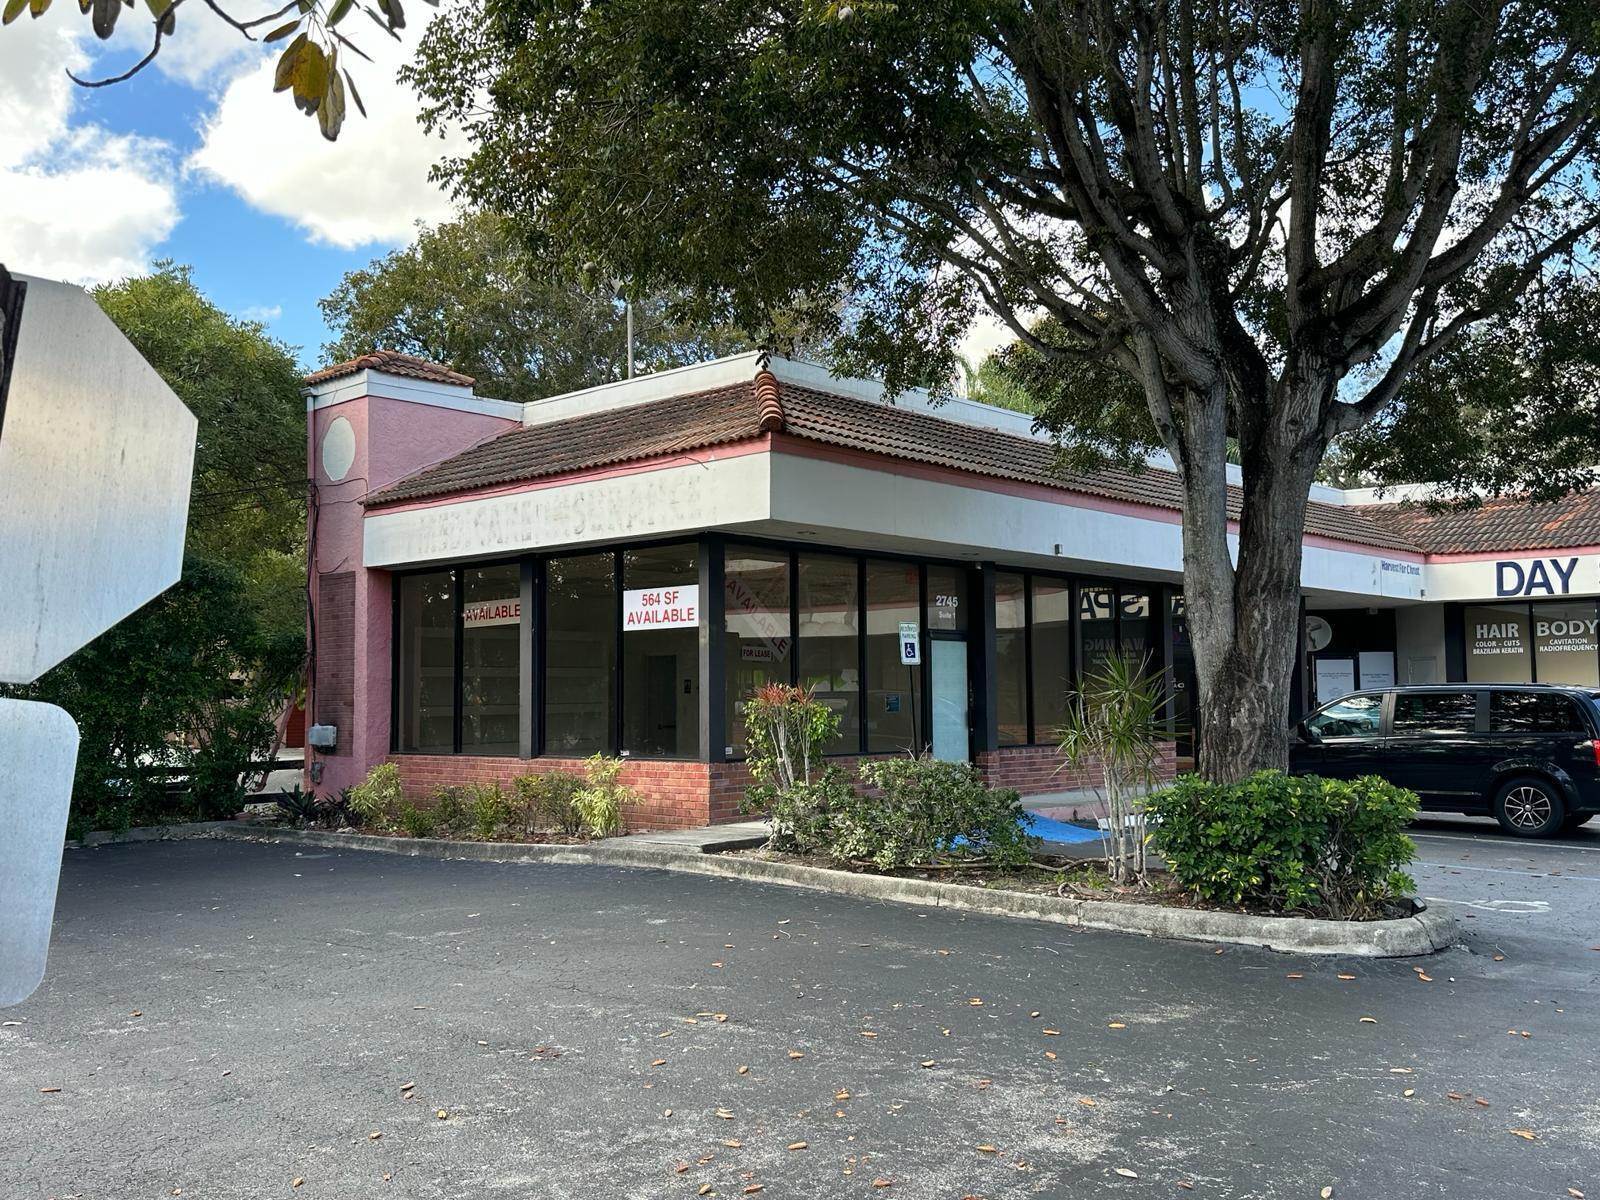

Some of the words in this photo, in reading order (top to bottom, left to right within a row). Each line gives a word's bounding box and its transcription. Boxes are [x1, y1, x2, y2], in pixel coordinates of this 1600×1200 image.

[1496, 558, 1579, 596] DAY
[642, 594, 661, 606] 564
[664, 591, 679, 604] SF
[936, 595, 958, 608] 2745
[465, 603, 521, 621] AVAILABLE
[627, 607, 694, 625] AVAILABLE
[726, 580, 788, 654] AVAILABLE
[1476, 623, 1518, 638] HAIR
[1536, 620, 1599, 637] BODY
[743, 649, 753, 657] FOR
[1539, 644, 1599, 652] RADIOFREQUENCY
